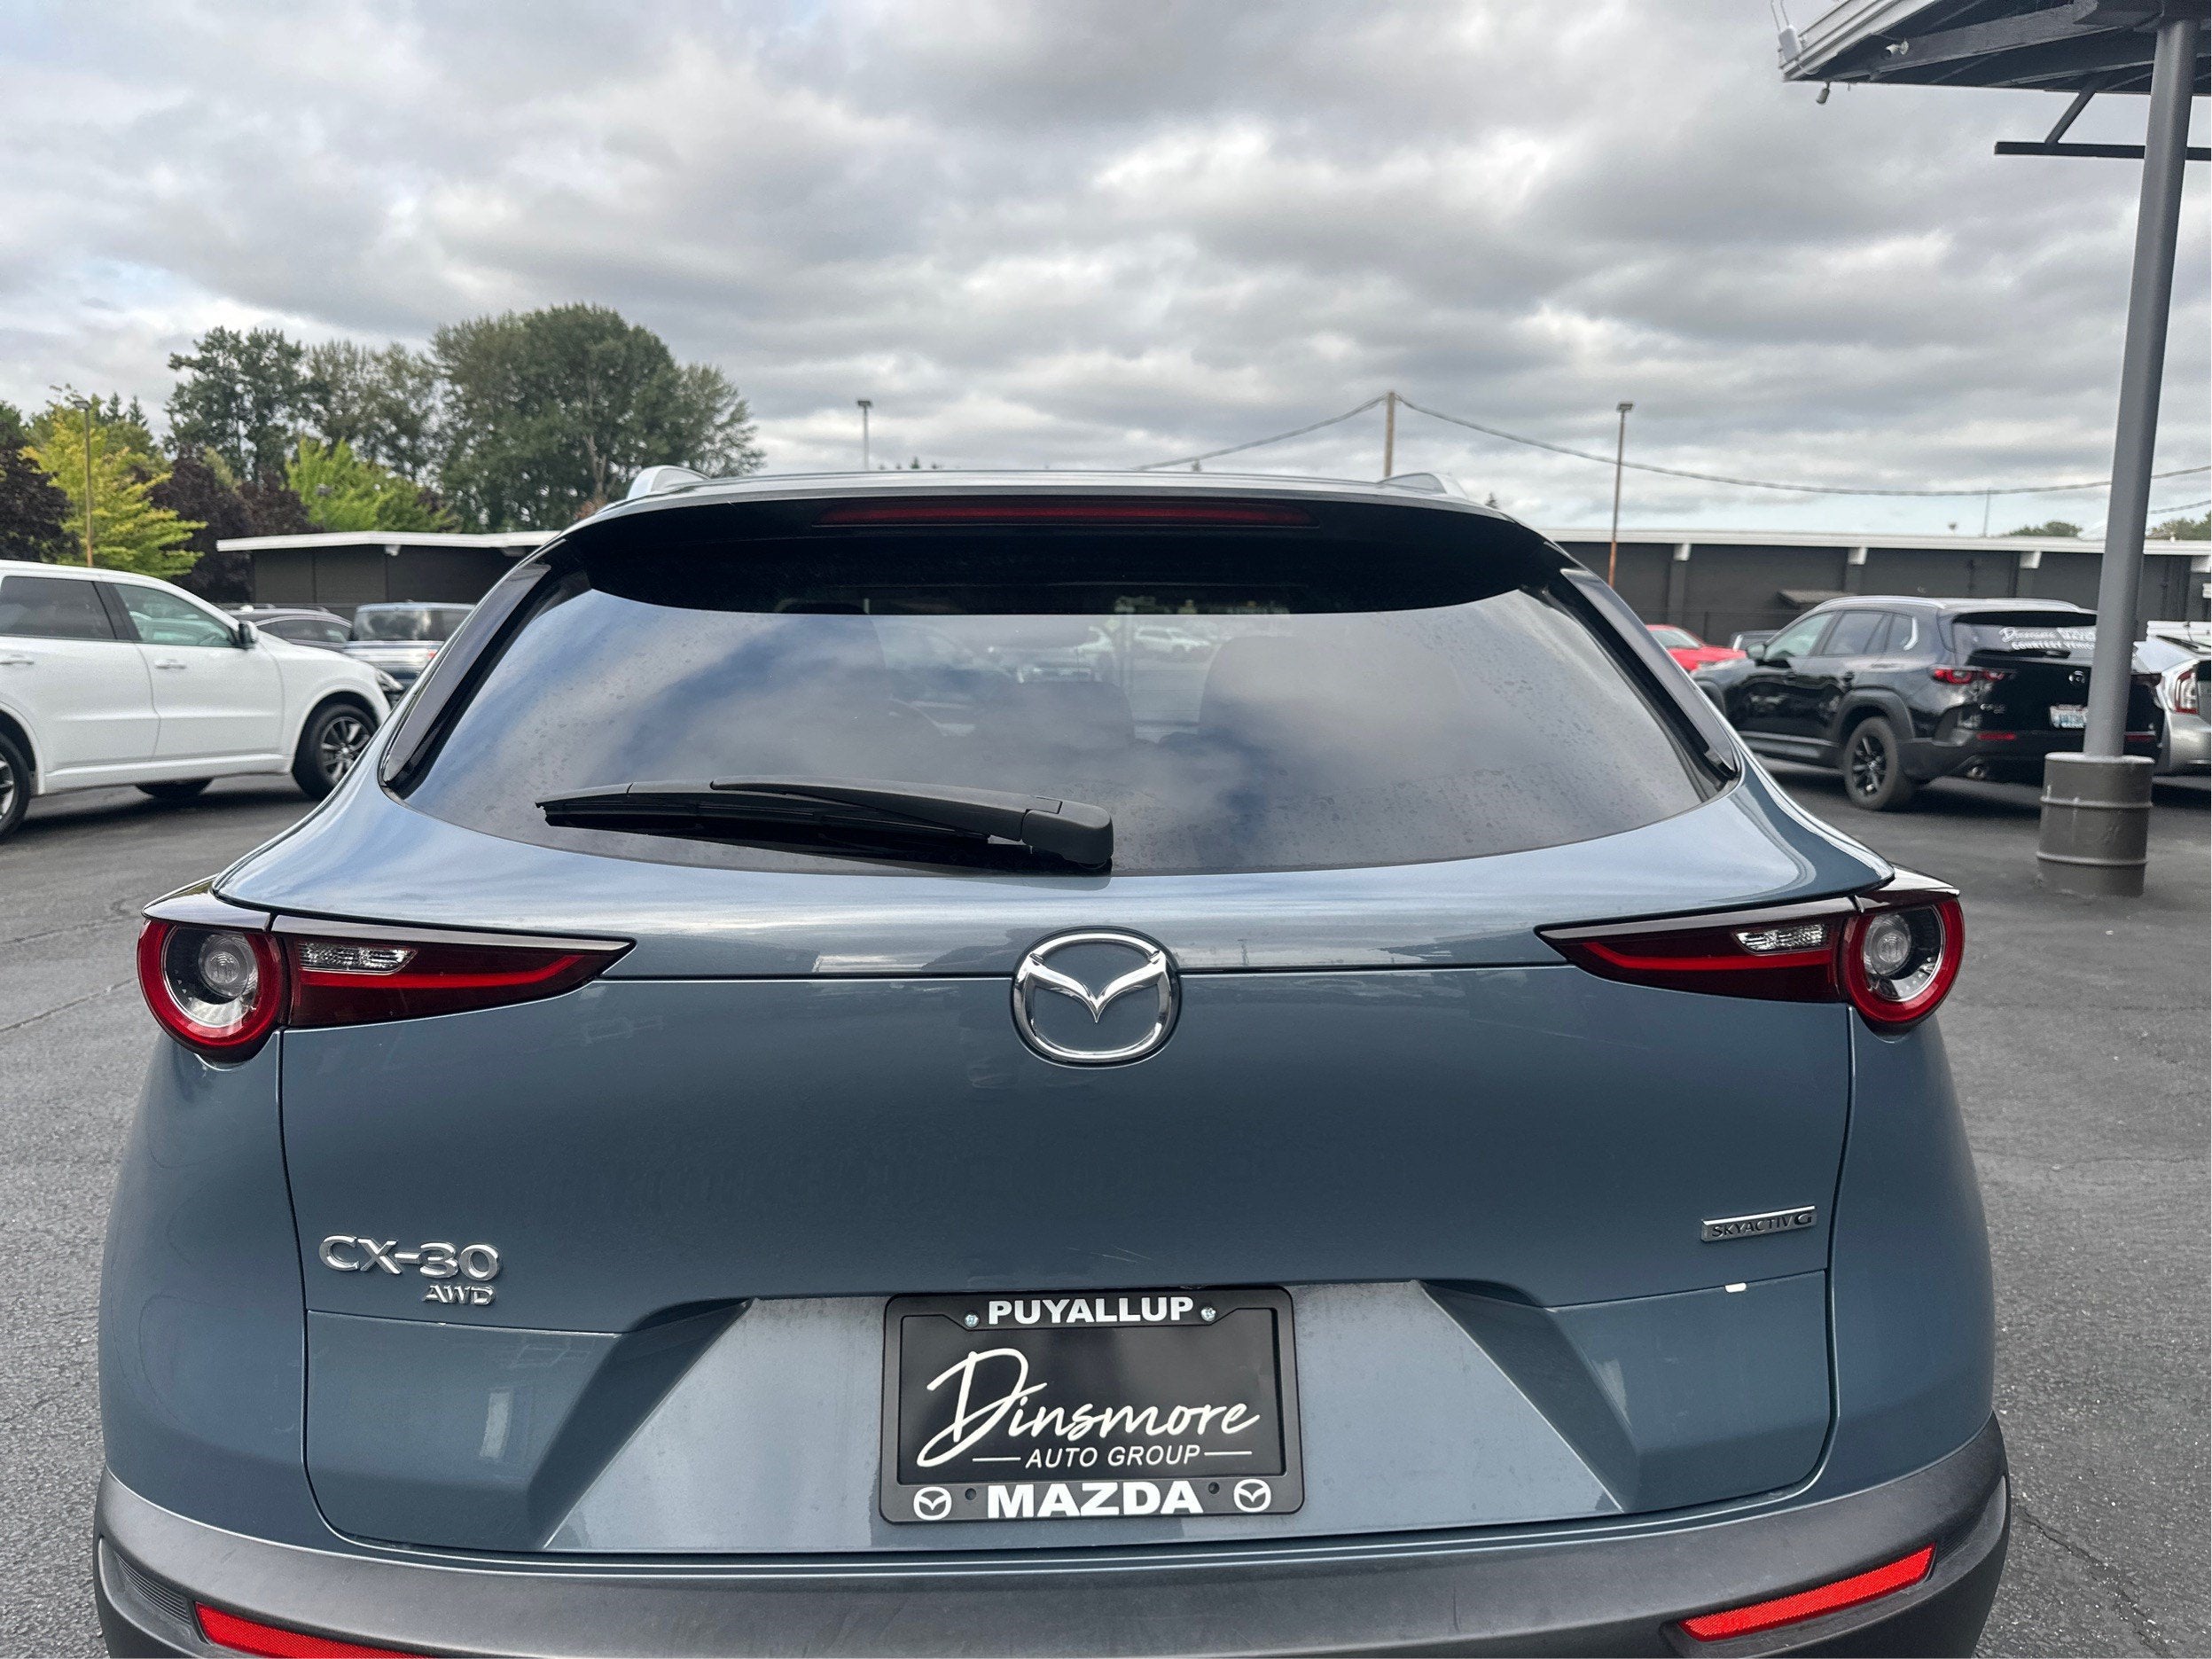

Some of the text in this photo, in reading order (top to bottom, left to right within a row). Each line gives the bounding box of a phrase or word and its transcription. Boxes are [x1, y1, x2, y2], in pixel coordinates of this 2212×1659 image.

[319, 1235, 500, 1280] CX-30
[422, 1284, 496, 1305] AWD
[989, 1297, 1193, 1325] PUYALLUP
[917, 1349, 1260, 1467] Dinsmore
[1026, 1445, 1200, 1467] AUTO GROUP
[988, 1481, 1203, 1519] MAZDA
